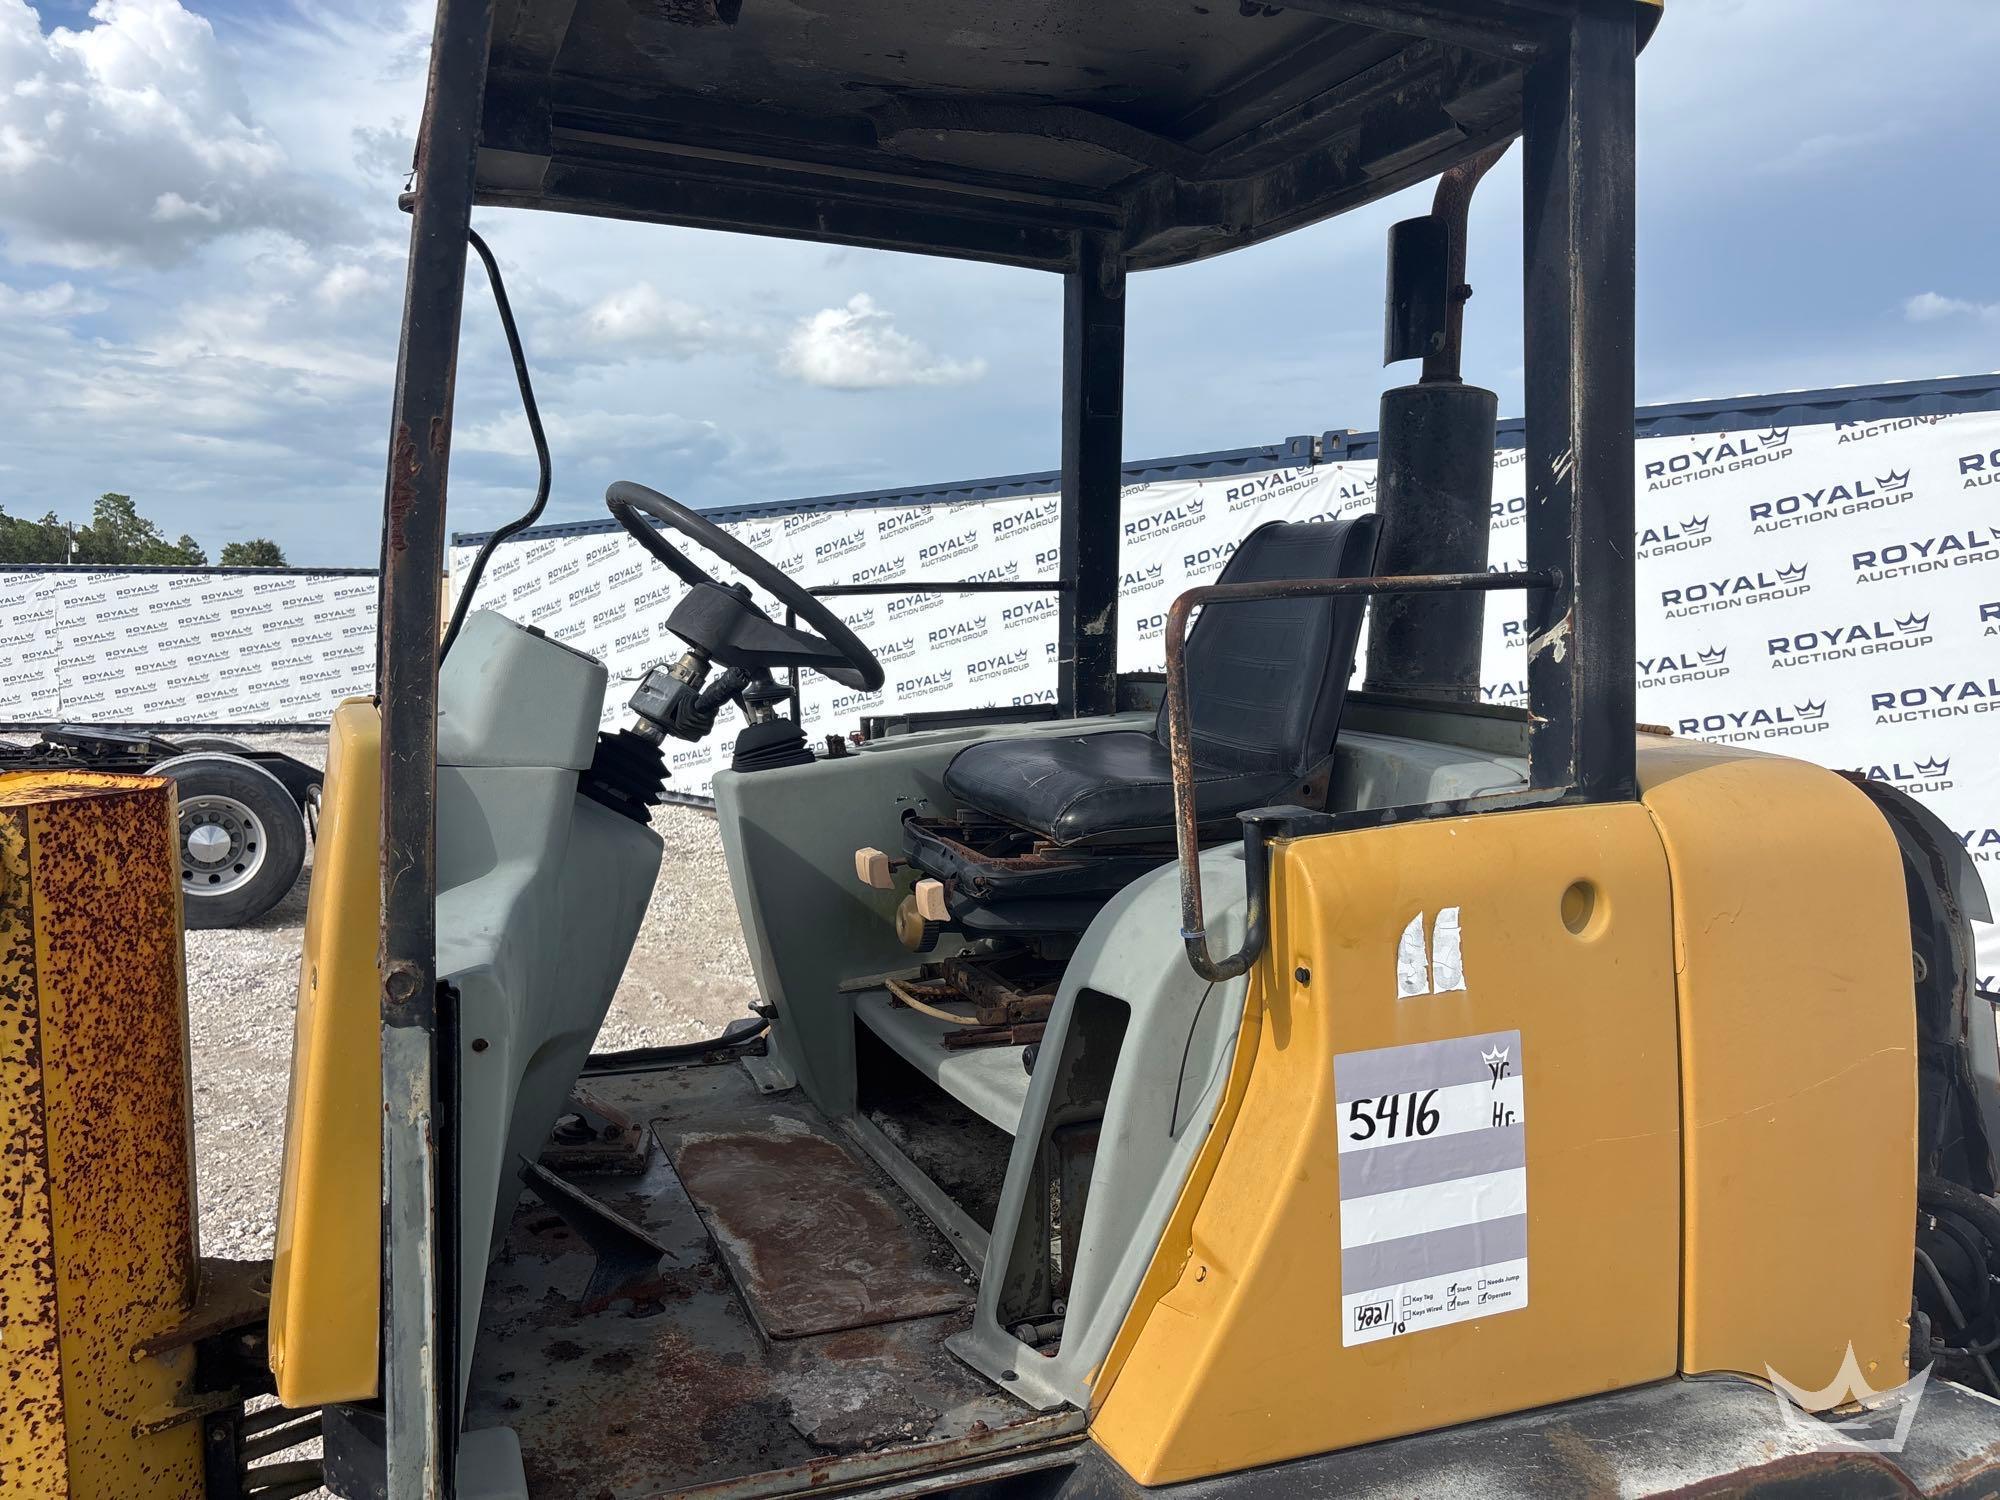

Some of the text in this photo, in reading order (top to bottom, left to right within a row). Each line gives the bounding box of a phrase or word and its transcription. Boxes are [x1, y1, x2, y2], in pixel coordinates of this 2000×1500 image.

[1645, 438, 1758, 479] ROYAL
[1648, 448, 1792, 492] AUCTION GROUP
[1226, 470, 1296, 501] ROYAL
[1229, 490, 1276, 512] AUCTION
[1278, 477, 1319, 496] GROUP
[1750, 481, 1875, 521] ROYAL
[1753, 491, 1913, 534] AUCTION GROUP
[878, 510, 920, 533] ROYAL
[880, 516, 934, 540] AUCTION GROUP
[993, 508, 1043, 534] ROYAL
[995, 515, 1059, 542] AUCTION GROUP
[1125, 507, 1187, 536] ROYAL
[1491, 515, 1526, 530] AUCT
[1127, 515, 1206, 545] AUCTION GROUP
[526, 543, 549, 559] ROYAL
[586, 543, 612, 561] ROYAL
[816, 535, 854, 557] ROYAL
[817, 542, 866, 564] AUCTION GROUP
[919, 537, 965, 560] ROYAL
[1184, 539, 1241, 568] ROYA
[1652, 536, 1712, 557] GROUP
[1852, 531, 1989, 570] ROYAL
[921, 544, 979, 568] AUCTION GROUP
[493, 561, 514, 576] ROYAL
[548, 563, 572, 579] ROYAL
[853, 562, 893, 583] ROYAL
[1856, 550, 2000, 584] AUCTION GRO
[4, 574, 36, 584] ROYAL
[609, 567, 636, 584] ROYAL
[117, 586, 149, 596] ROYAL
[254, 581, 286, 591] ROYAL
[513, 580, 535, 596] ROYAL
[569, 585, 594, 602] ROYAL
[1131, 579, 1164, 593] GROUP
[1662, 572, 1775, 607] ROYAL
[64, 595, 96, 605] ROYAL
[202, 590, 234, 600] ROYAL
[634, 588, 662, 606] ROYAL
[888, 593, 931, 613] ROYAL
[1665, 584, 1811, 619] AUCTION GROUP
[149, 600, 182, 610] ROYAL
[230, 605, 263, 615] ROYAL
[532, 602, 555, 618] ROYAL
[889, 600, 944, 621] AUCTION GROUP
[1003, 598, 1054, 621] ROYAL
[13, 611, 45, 621] ROYAL
[97, 609, 129, 619] ROYAL
[178, 614, 211, 624] ROYAL
[593, 607, 618, 623] ROYAL
[1005, 610, 1058, 630] AUCTION GRO
[126, 624, 158, 634] ROYAL
[342, 624, 375, 634] ROYAL
[554, 623, 578, 639] ROYAL
[929, 621, 974, 642] ROYAL
[1139, 629, 1163, 640] AUCT
[73, 633, 106, 643] ROYAL
[291, 634, 324, 644] ROYAL
[615, 630, 642, 647] ROYAL
[931, 630, 988, 651] AUCTION GROUP
[1768, 622, 1894, 655] ROYAL
[22, 649, 54, 659] ROYAL
[106, 647, 138, 657] ROYAL
[240, 643, 272, 653] ROYAL
[870, 642, 903, 657] OYAL
[892, 651, 915, 661] GROUP
[1772, 635, 1933, 668] AUCTION GROUP
[188, 652, 220, 662] ROYAL
[967, 654, 1015, 675] ROYAL
[1637, 654, 1697, 675] YAL
[135, 661, 168, 671] ROYAL
[220, 666, 252, 676] ROYAL
[969, 663, 1029, 683] AUCTION GROUP
[2, 672, 35, 682] ROYAL
[168, 675, 200, 685] ROYAL
[300, 671, 332, 681] ROYAL
[897, 674, 940, 693] ROYAL
[1670, 668, 1730, 684] GROUP
[31, 688, 58, 697] ROYA
[115, 684, 148, 694] ROYAL
[331, 685, 363, 694] ROYAL
[898, 683, 953, 701] AUCTION GROUP
[1480, 681, 1527, 699] YAL
[63, 694, 96, 704] ROYAL
[280, 694, 312, 704] ROYAL
[832, 692, 872, 708] ROYAL
[92, 708, 124, 718] ROYAL
[228, 703, 261, 713] ROYAL
[308, 710, 334, 718] ROYA
[834, 700, 884, 716] AUCTION GROUP
[1875, 705, 1968, 725] AUCTION
[176, 712, 209, 722] ROYAL
[1679, 707, 1794, 734] ROYAL
[1764, 722, 1829, 738] GROUP
[673, 749, 703, 763] ROYAL
[1898, 781, 1953, 793] ROUP
[1350, 1089, 1439, 1140] 5416
[1492, 1102, 1515, 1127] Hr.
[1487, 1275, 1519, 1286] Needs Jump
[1457, 1285, 1472, 1293] Starts
[1487, 1290, 1511, 1300] Operates
[1424, 1293, 1433, 1302] Tag
[1412, 1305, 1442, 1317] Keys Wired
